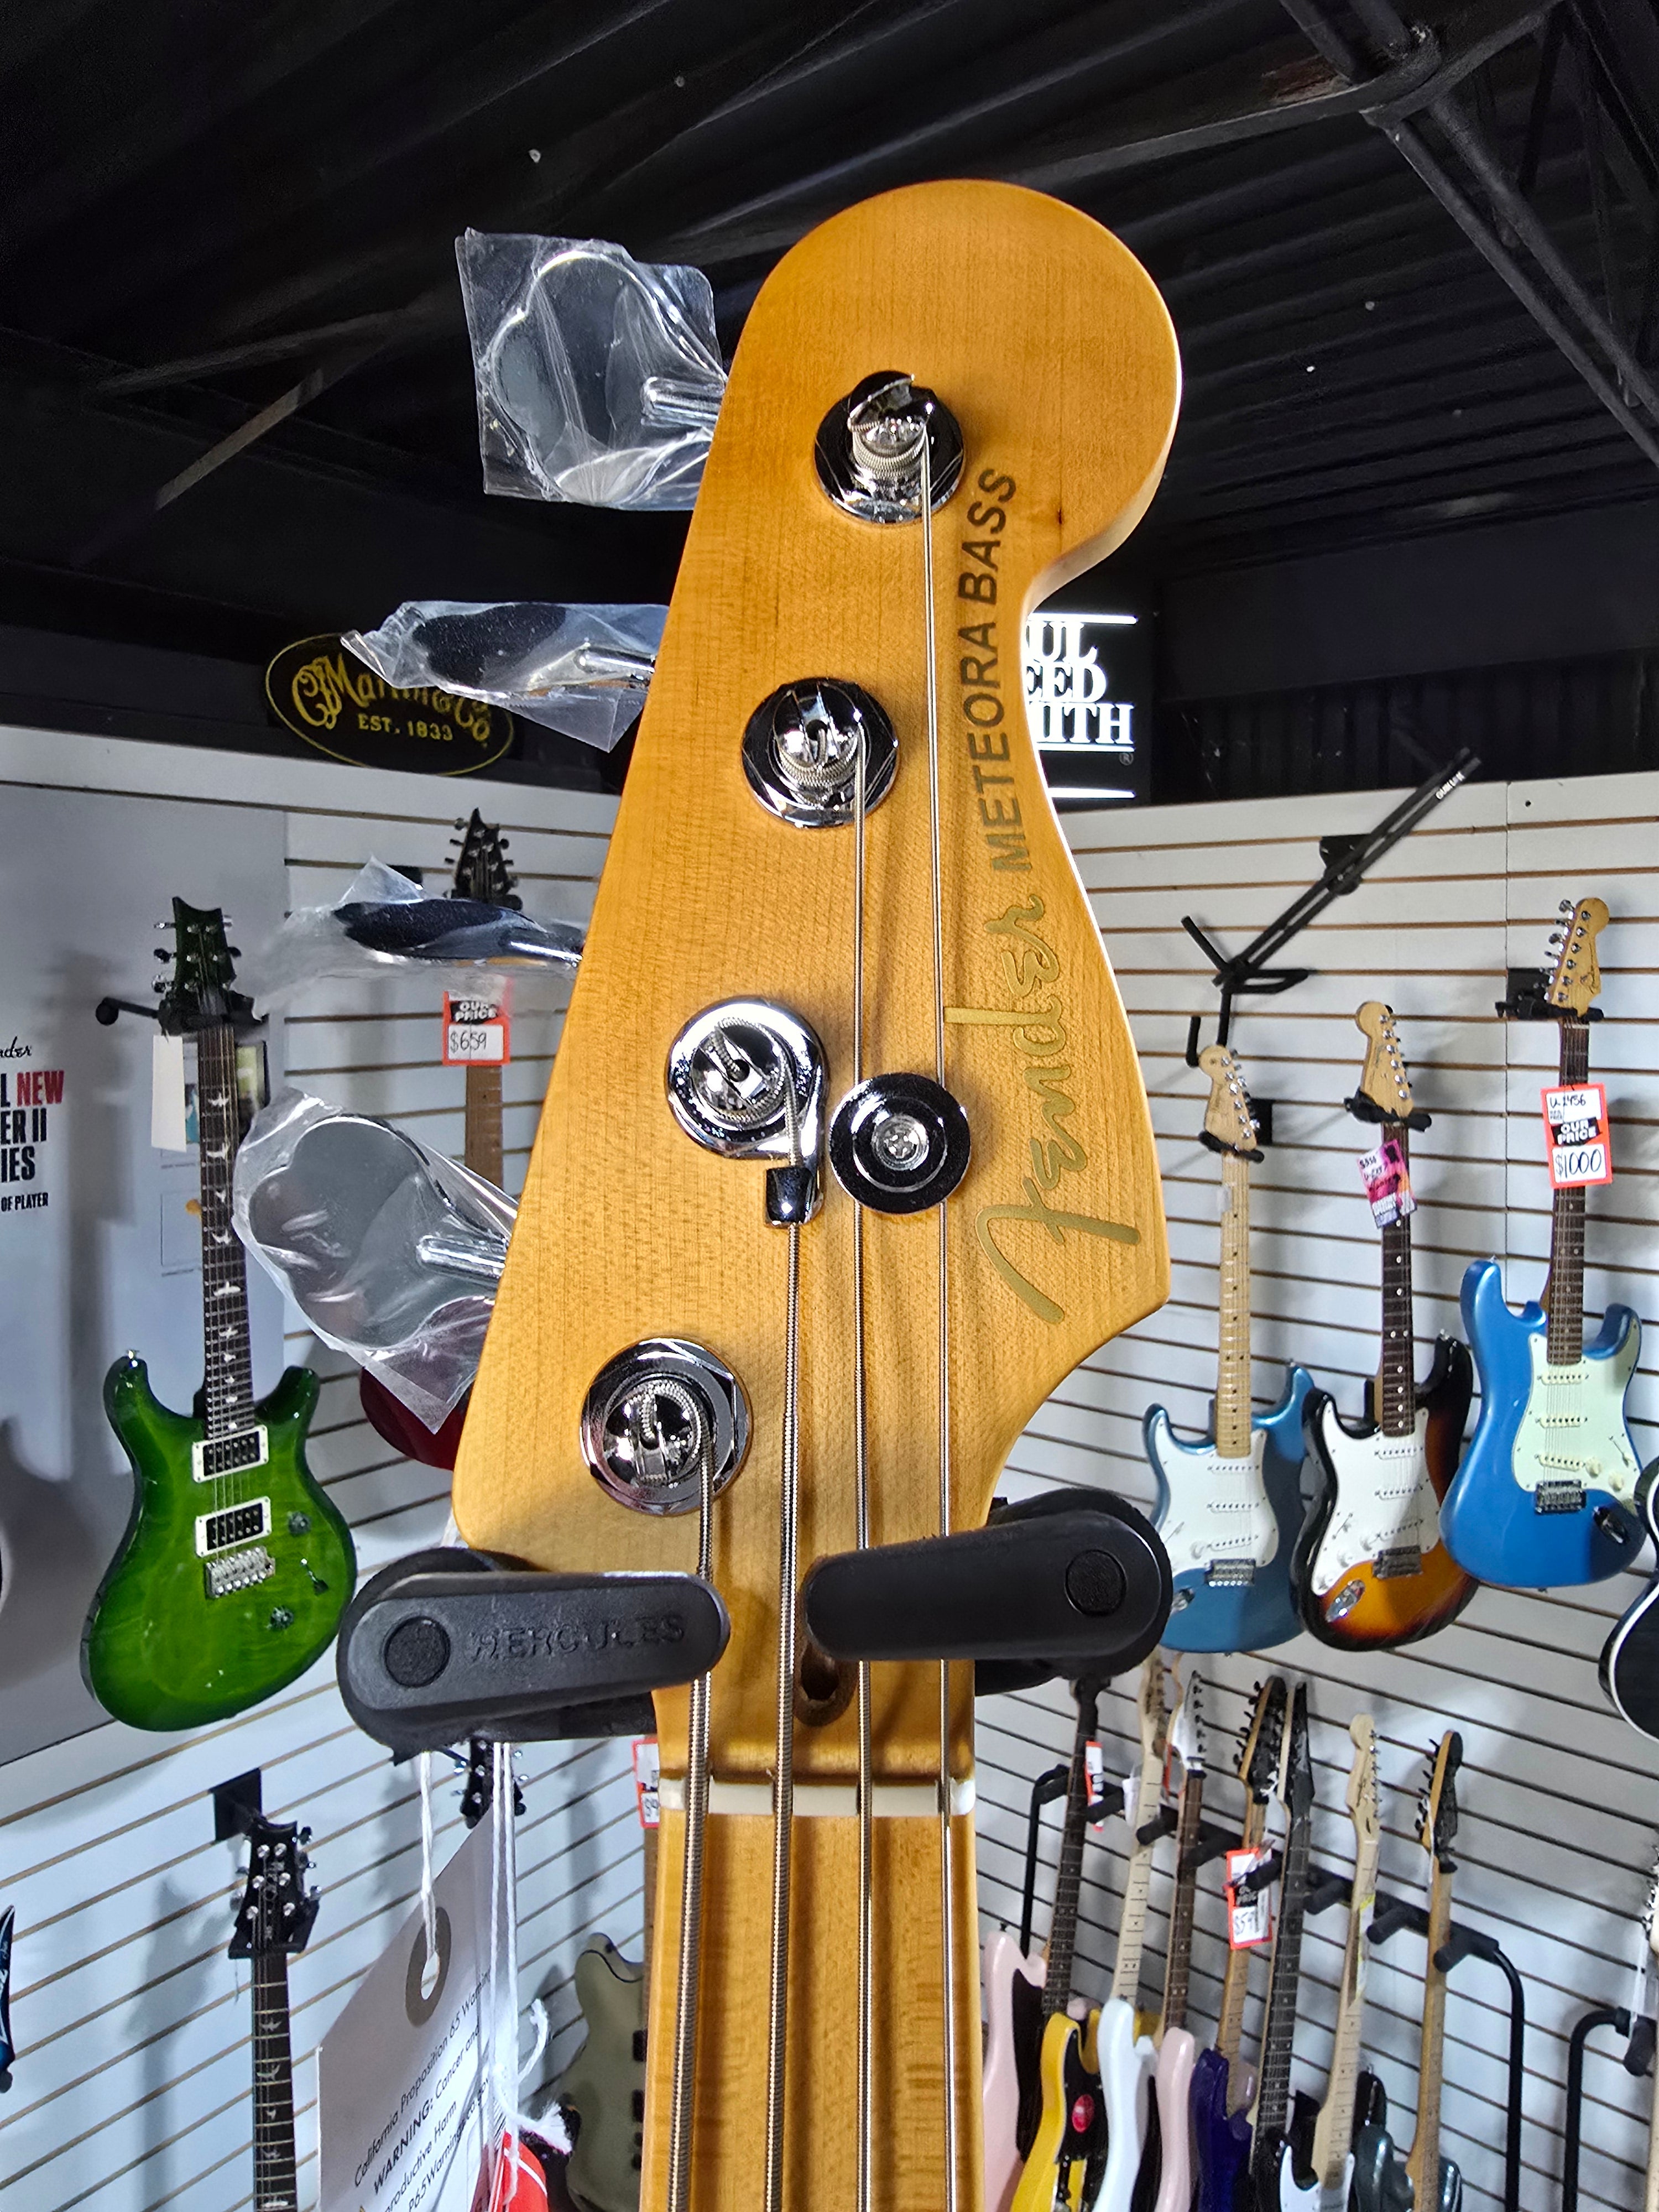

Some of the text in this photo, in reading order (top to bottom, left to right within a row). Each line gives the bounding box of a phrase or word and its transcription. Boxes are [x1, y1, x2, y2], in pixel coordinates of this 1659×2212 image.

[1026, 622, 1098, 664] UL
[957, 468, 1032, 872] METEORA BASS
[357, 712, 453, 741] EST. 1833
[1030, 702, 1135, 744] ITH
[455, 1008, 497, 1022] PRICE
[450, 1030, 487, 1053] $659
[17, 1071, 65, 1107] NEW
[32, 1108, 47, 1142] II
[943, 894, 1140, 1324] Fender
[1561, 1119, 1589, 1134] OUR
[1557, 1126, 1597, 1145] PRICE
[1555, 1149, 1602, 1179] $1000
[1, 1192, 49, 1212] OF PLAYER
[465, 1614, 685, 1660] HERCULES
[354, 1964, 491, 2187] California Proposition 65 Warnin
[374, 2016, 479, 2195] WARNING: Cancer and
[434, 2100, 457, 2143] Harm
